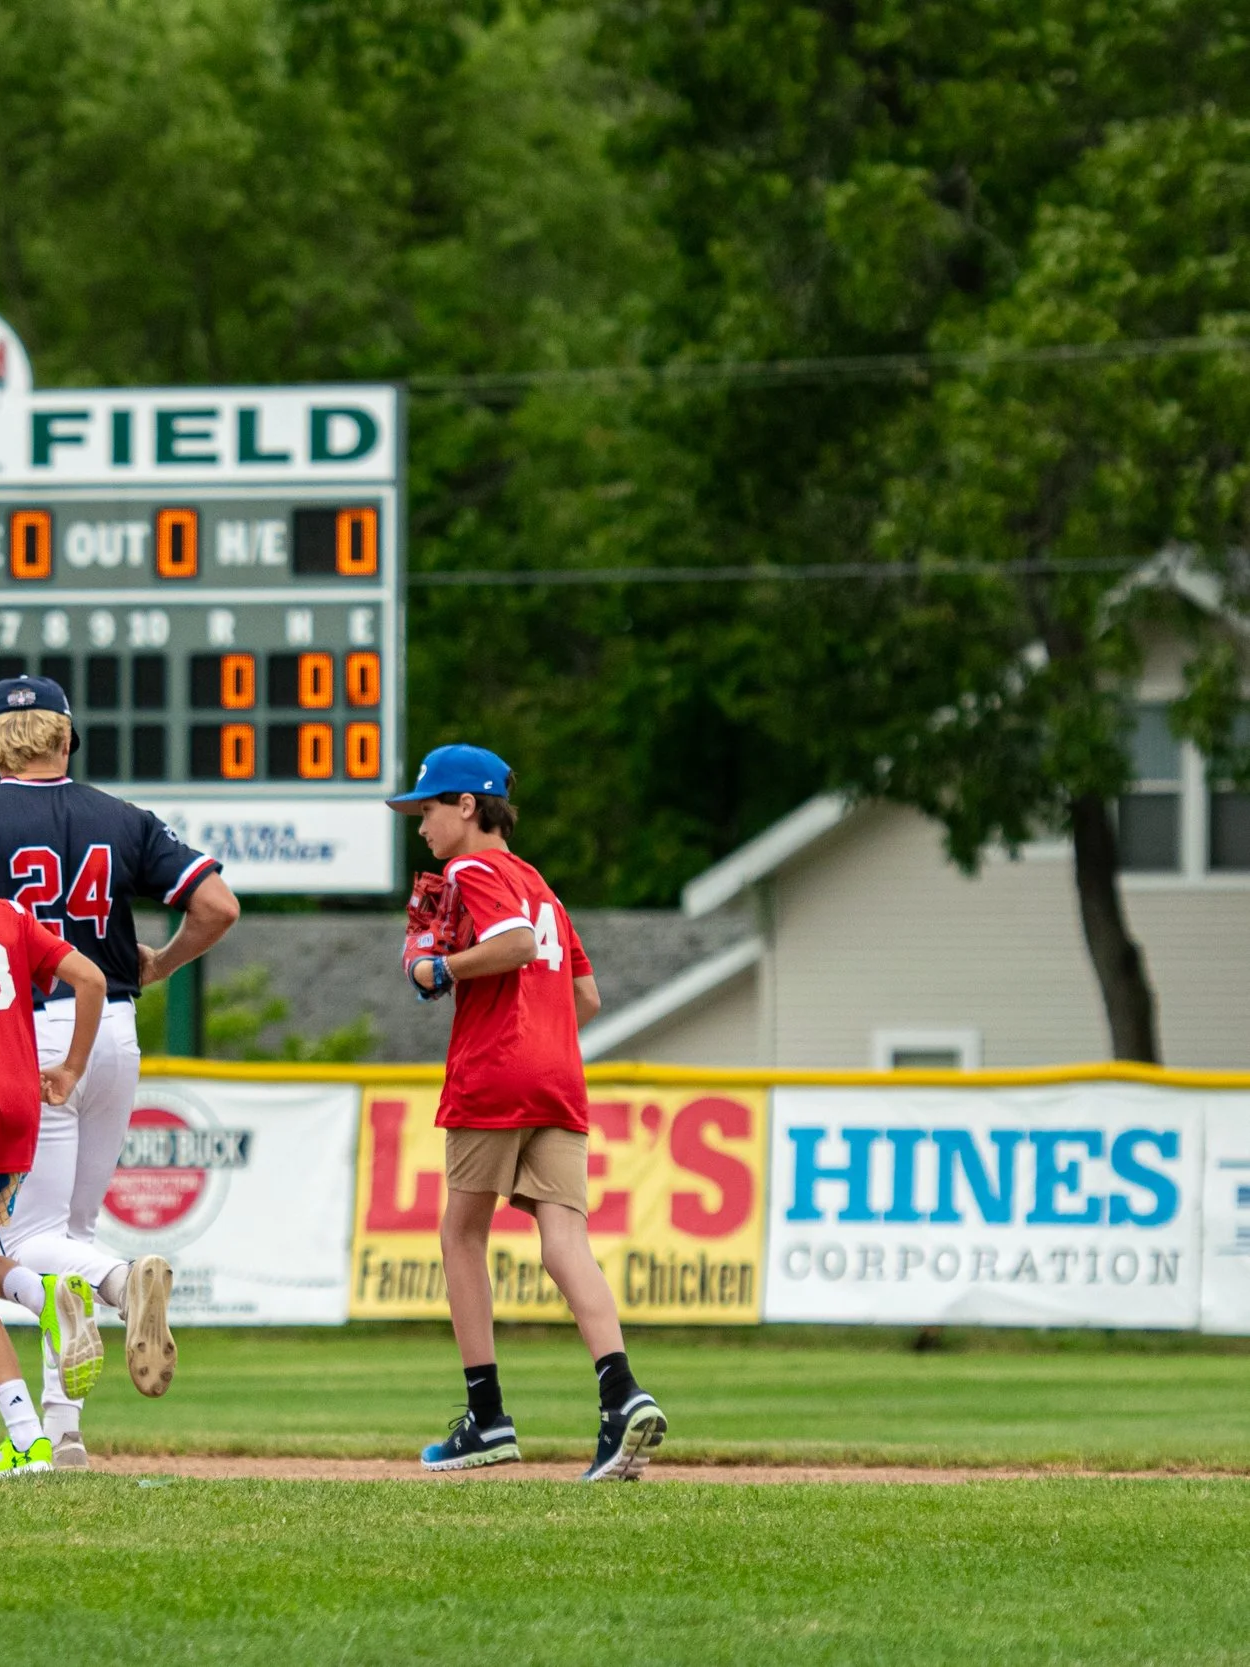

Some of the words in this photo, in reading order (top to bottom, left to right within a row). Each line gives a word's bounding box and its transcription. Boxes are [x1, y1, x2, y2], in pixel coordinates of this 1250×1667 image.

[31, 407, 379, 467] FIELD
[10, 510, 51, 579] 0
[65, 520, 149, 567] OUT
[157, 508, 197, 577] 0
[216, 520, 288, 567] H/E
[336, 507, 378, 576] 0
[43, 611, 70, 648] 8
[88, 610, 116, 647] 9
[128, 610, 170, 647] 10
[208, 609, 236, 646] R
[285, 609, 314, 646] H
[349, 609, 376, 646] E
[221, 653, 255, 709] 0
[298, 653, 333, 709] 0
[345, 652, 380, 706] 0
[221, 723, 255, 779] 0
[298, 722, 333, 778] 0
[345, 722, 380, 778] 0
[10, 844, 114, 942] 24
[521, 899, 563, 971] 4
[365, 1095, 756, 1240] LE'S
[786, 1128, 1180, 1228] HINES
[624, 1250, 754, 1307] Chicken
[783, 1241, 1183, 1287] CORPORATION
